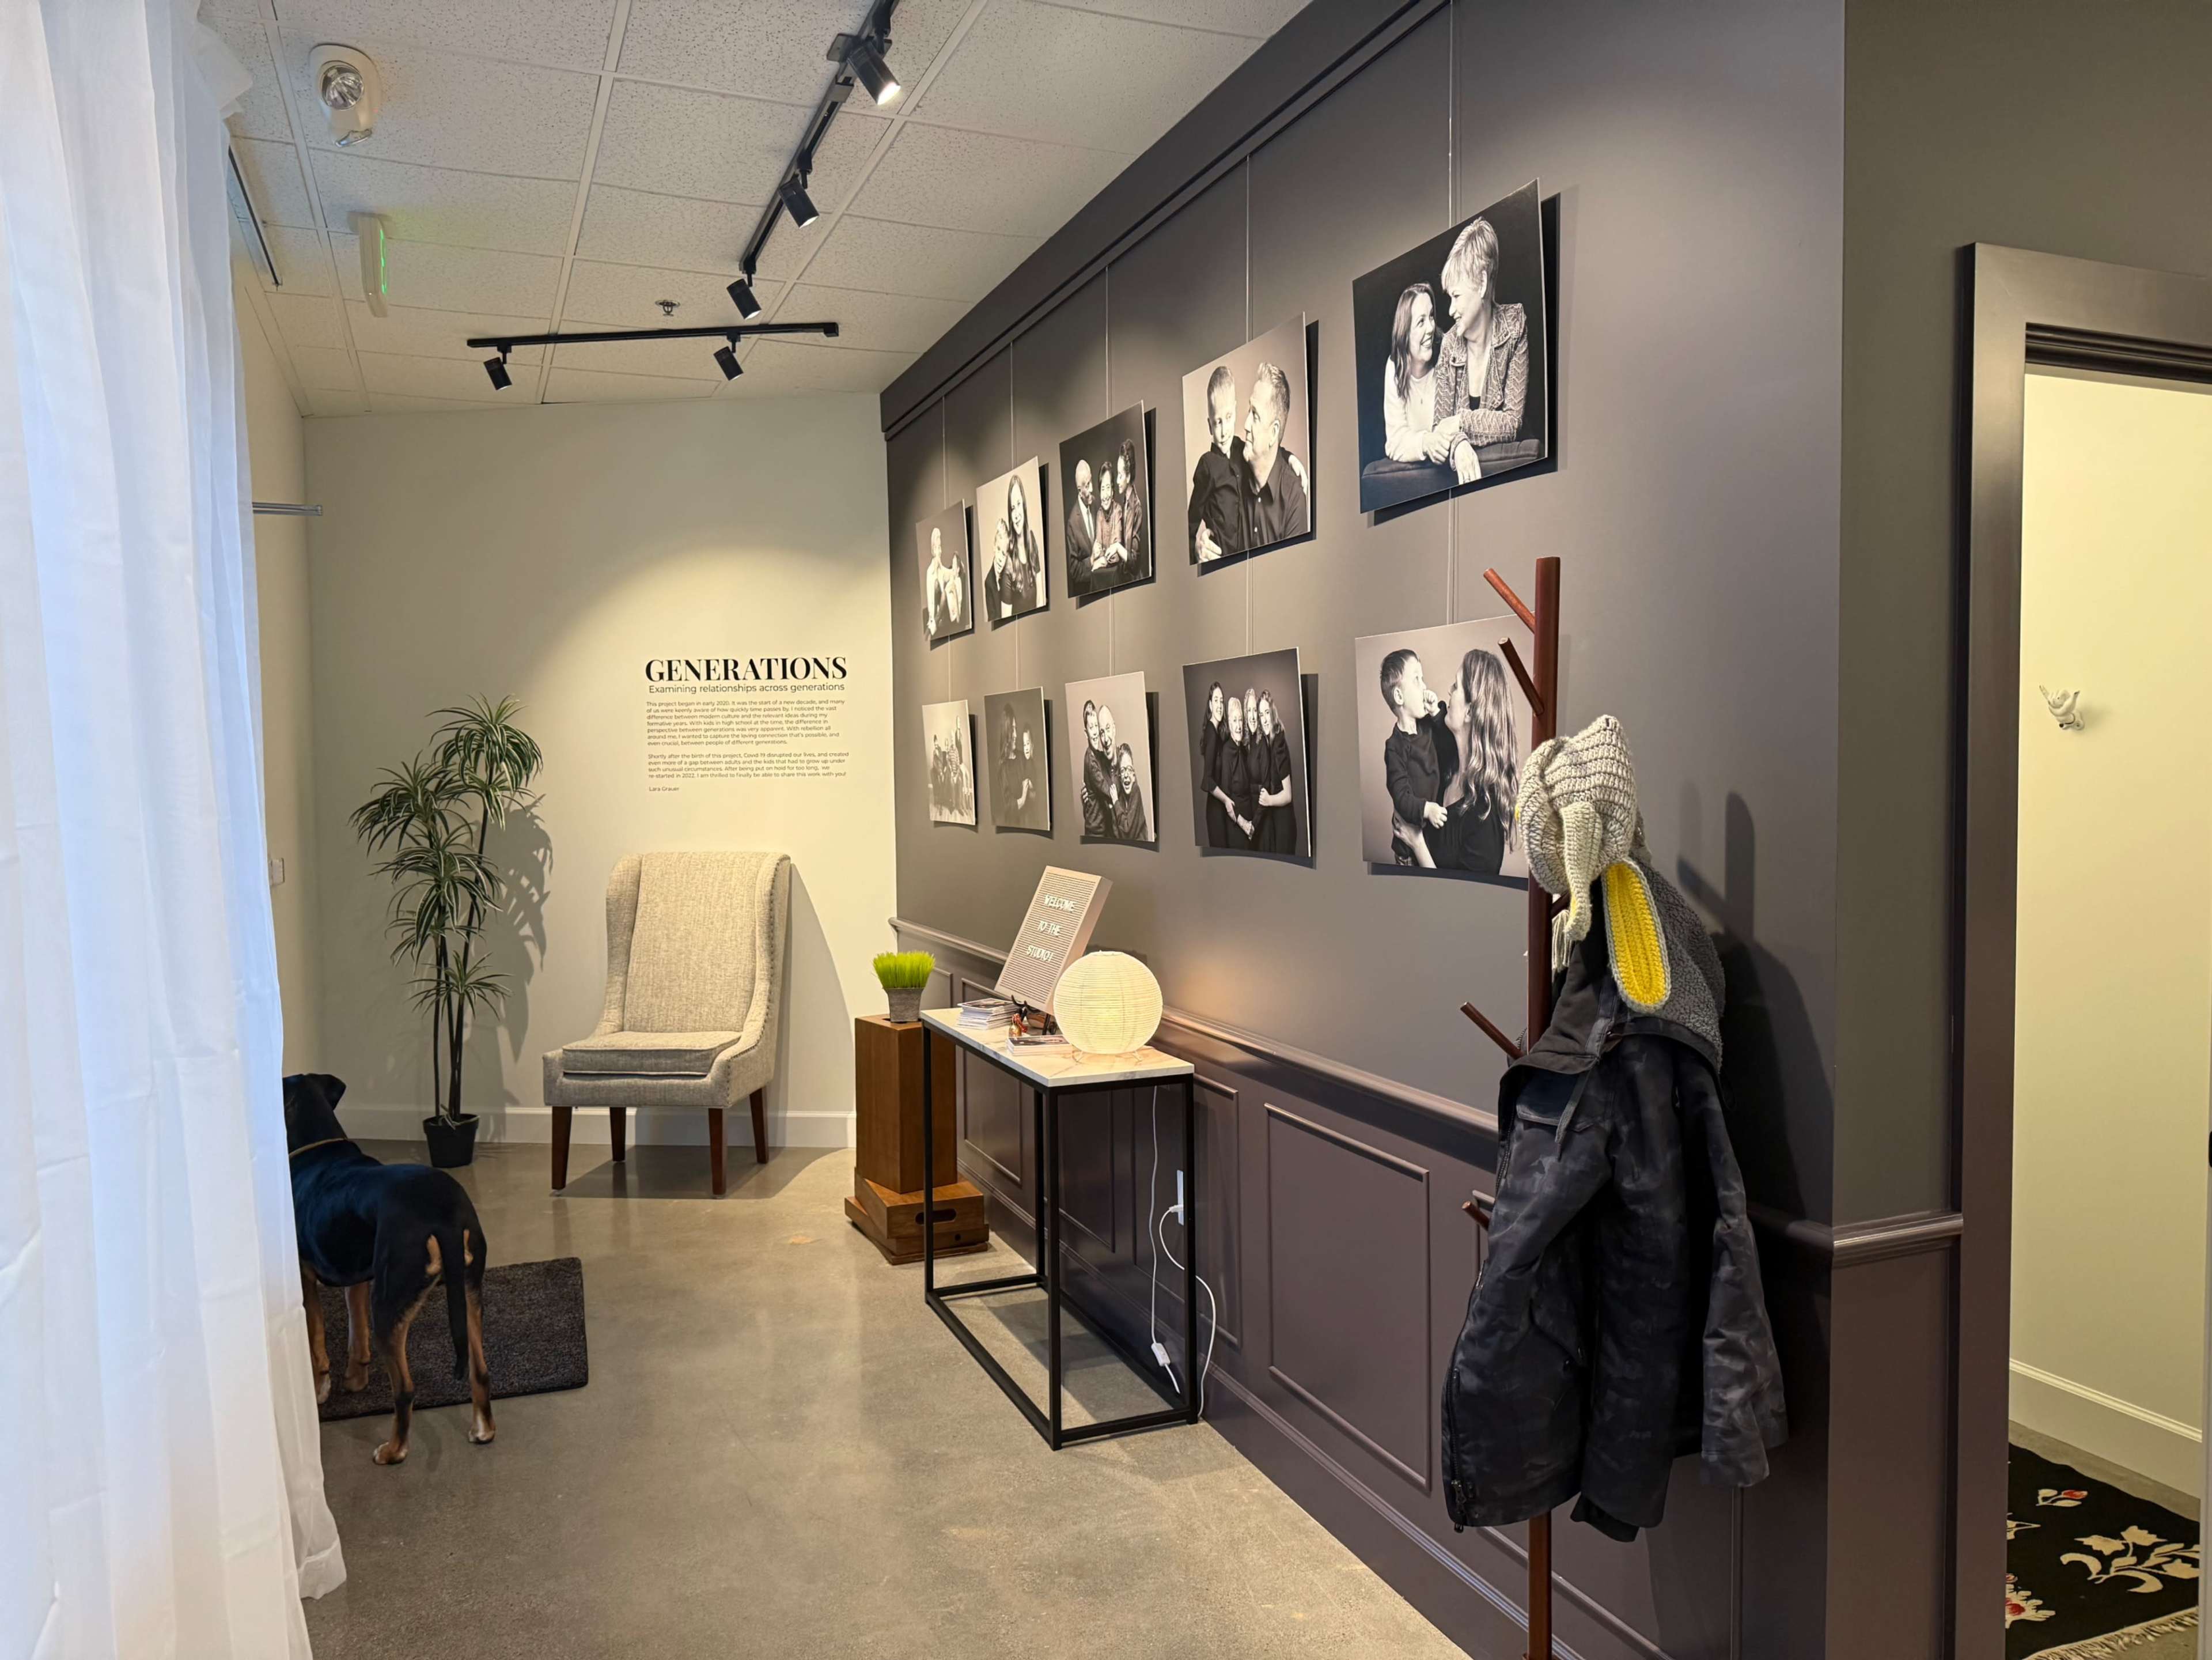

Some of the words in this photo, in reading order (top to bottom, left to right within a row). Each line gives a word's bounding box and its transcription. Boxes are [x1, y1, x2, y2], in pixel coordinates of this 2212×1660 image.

[645, 657, 847, 682] GENERATIONS
[649, 685, 696, 694] Examining
[699, 684, 757, 694] relationships
[790, 683, 844, 693] generations
[1044, 894, 1078, 913] WELCOME
[1037, 921, 1048, 933] TO
[1048, 923, 1061, 937] THE
